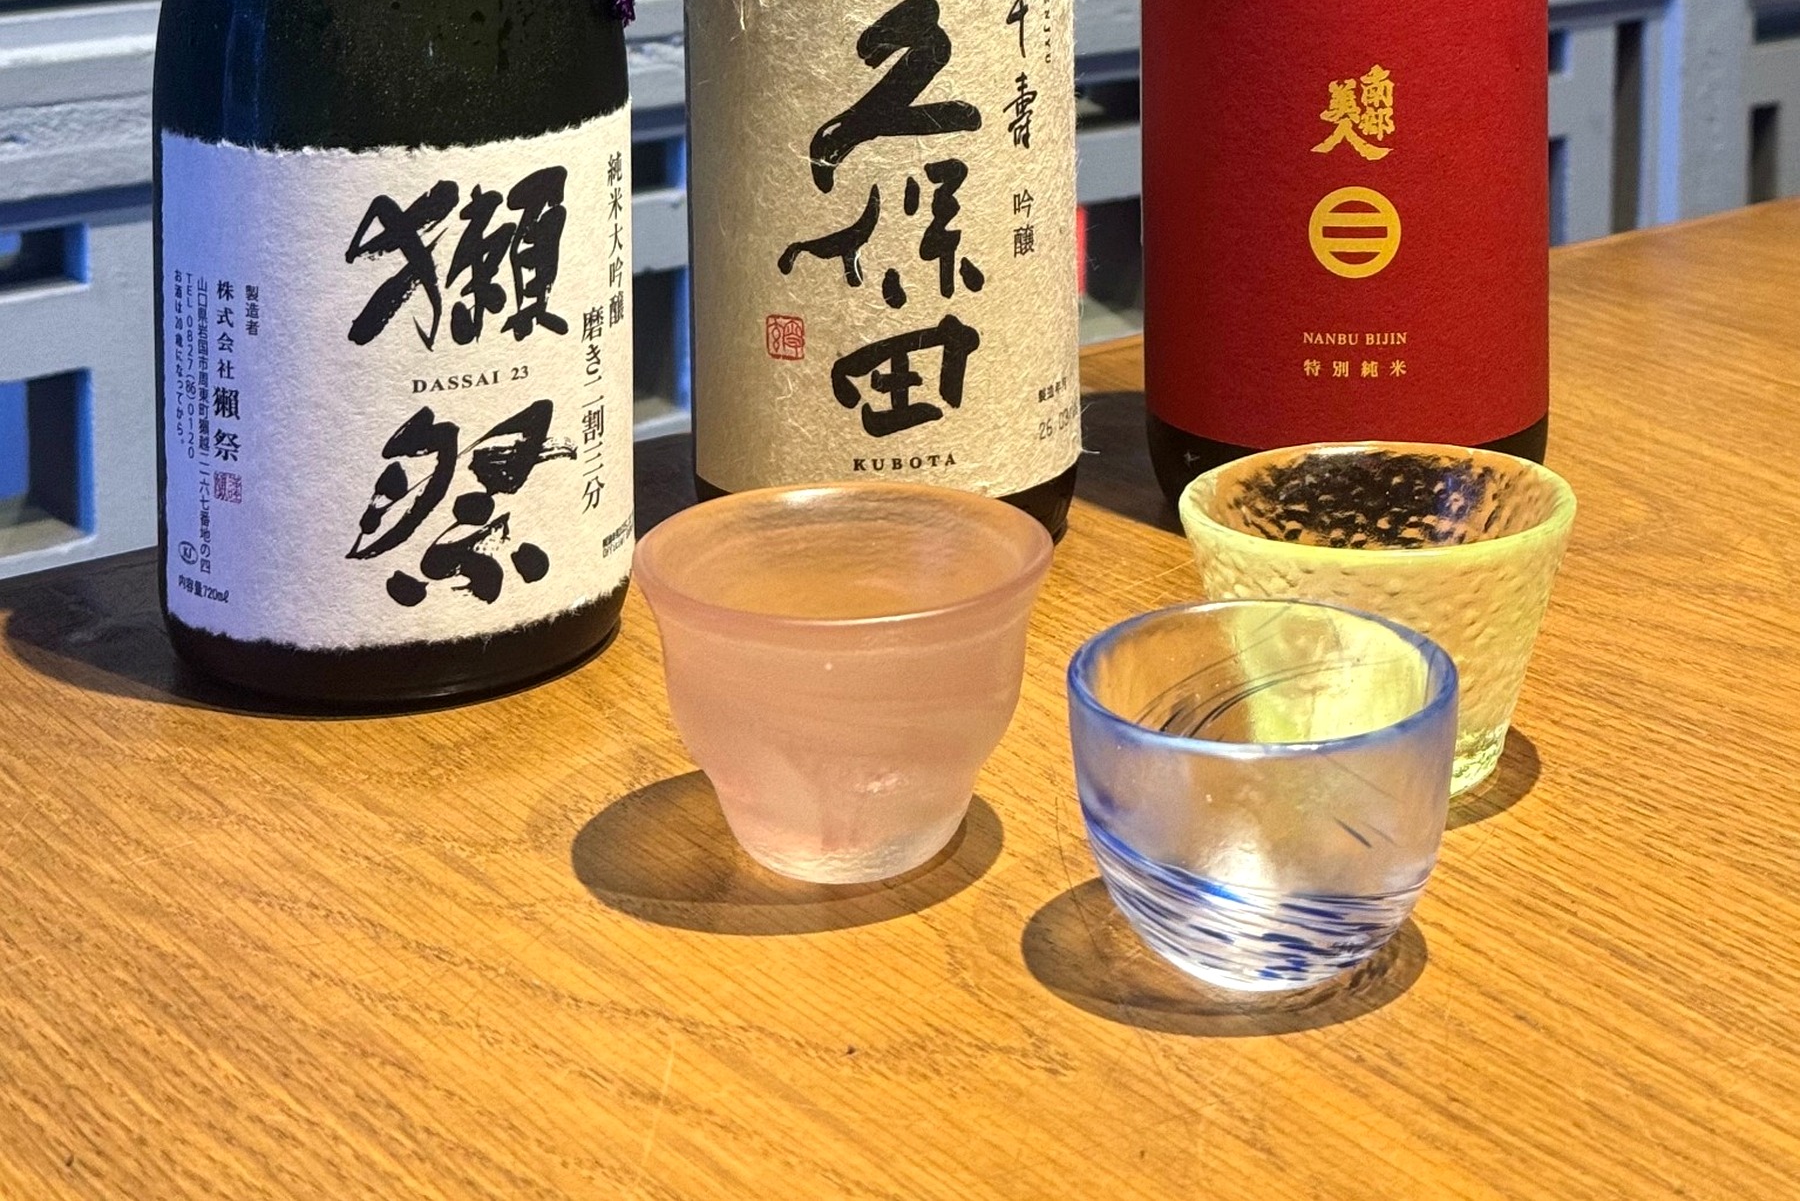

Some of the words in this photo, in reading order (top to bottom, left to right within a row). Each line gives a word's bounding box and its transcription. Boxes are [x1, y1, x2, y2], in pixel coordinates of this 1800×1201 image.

[245, 285, 259, 336] 製造者
[1303, 332, 1358, 345] NANBU
[1366, 332, 1407, 345] BIJIN
[412, 369, 499, 394] DASSAI
[510, 365, 529, 380] 23
[1303, 359, 1407, 378] 特別純米
[581, 306, 605, 514] 磨き二割三分
[853, 453, 956, 471] KUBOTA
